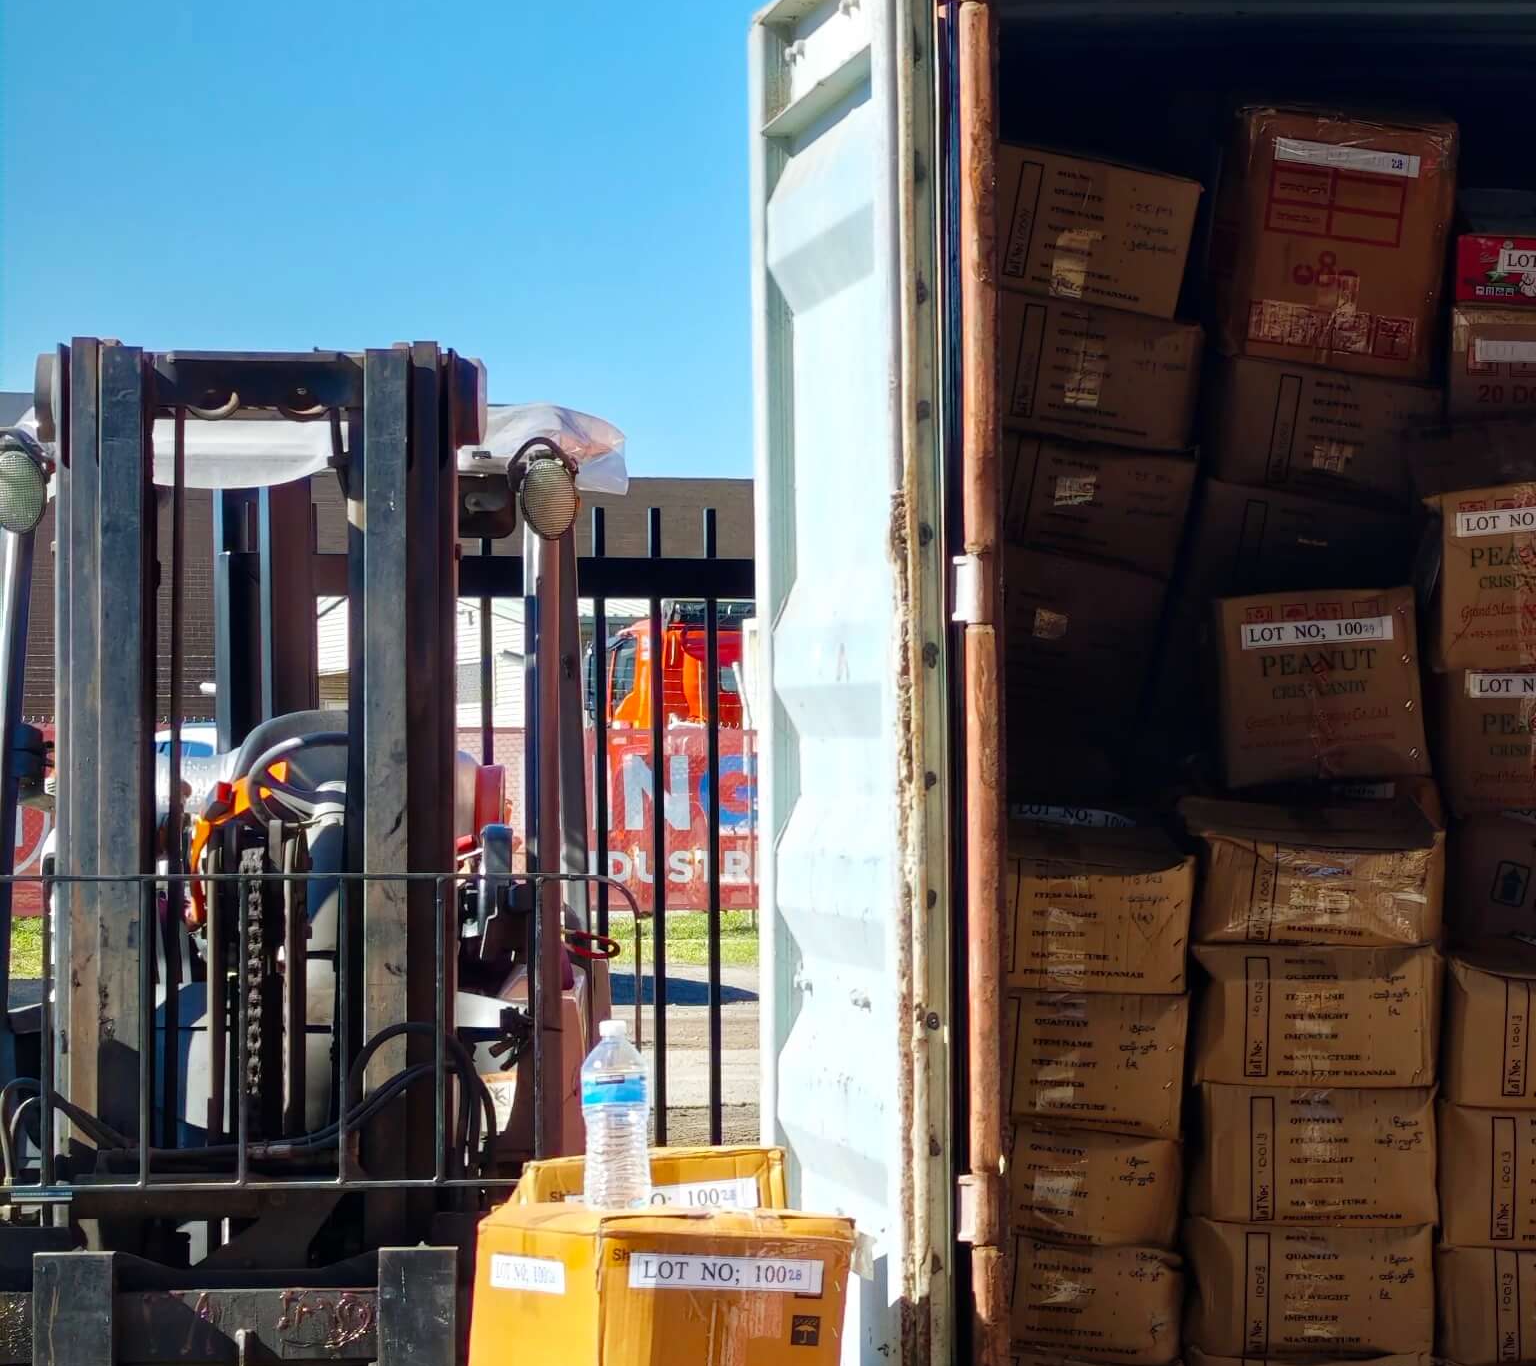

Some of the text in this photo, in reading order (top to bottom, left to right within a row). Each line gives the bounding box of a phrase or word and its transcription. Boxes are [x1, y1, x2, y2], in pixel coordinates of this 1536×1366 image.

[1478, 386, 1504, 404] 20
[1465, 515, 1499, 532] LOT
[1249, 626, 1285, 643] LOT
[1294, 624, 1327, 641] NO;
[1479, 678, 1508, 694] LOT
[642, 1259, 689, 1280] LOT
[700, 1262, 740, 1285] NO;
